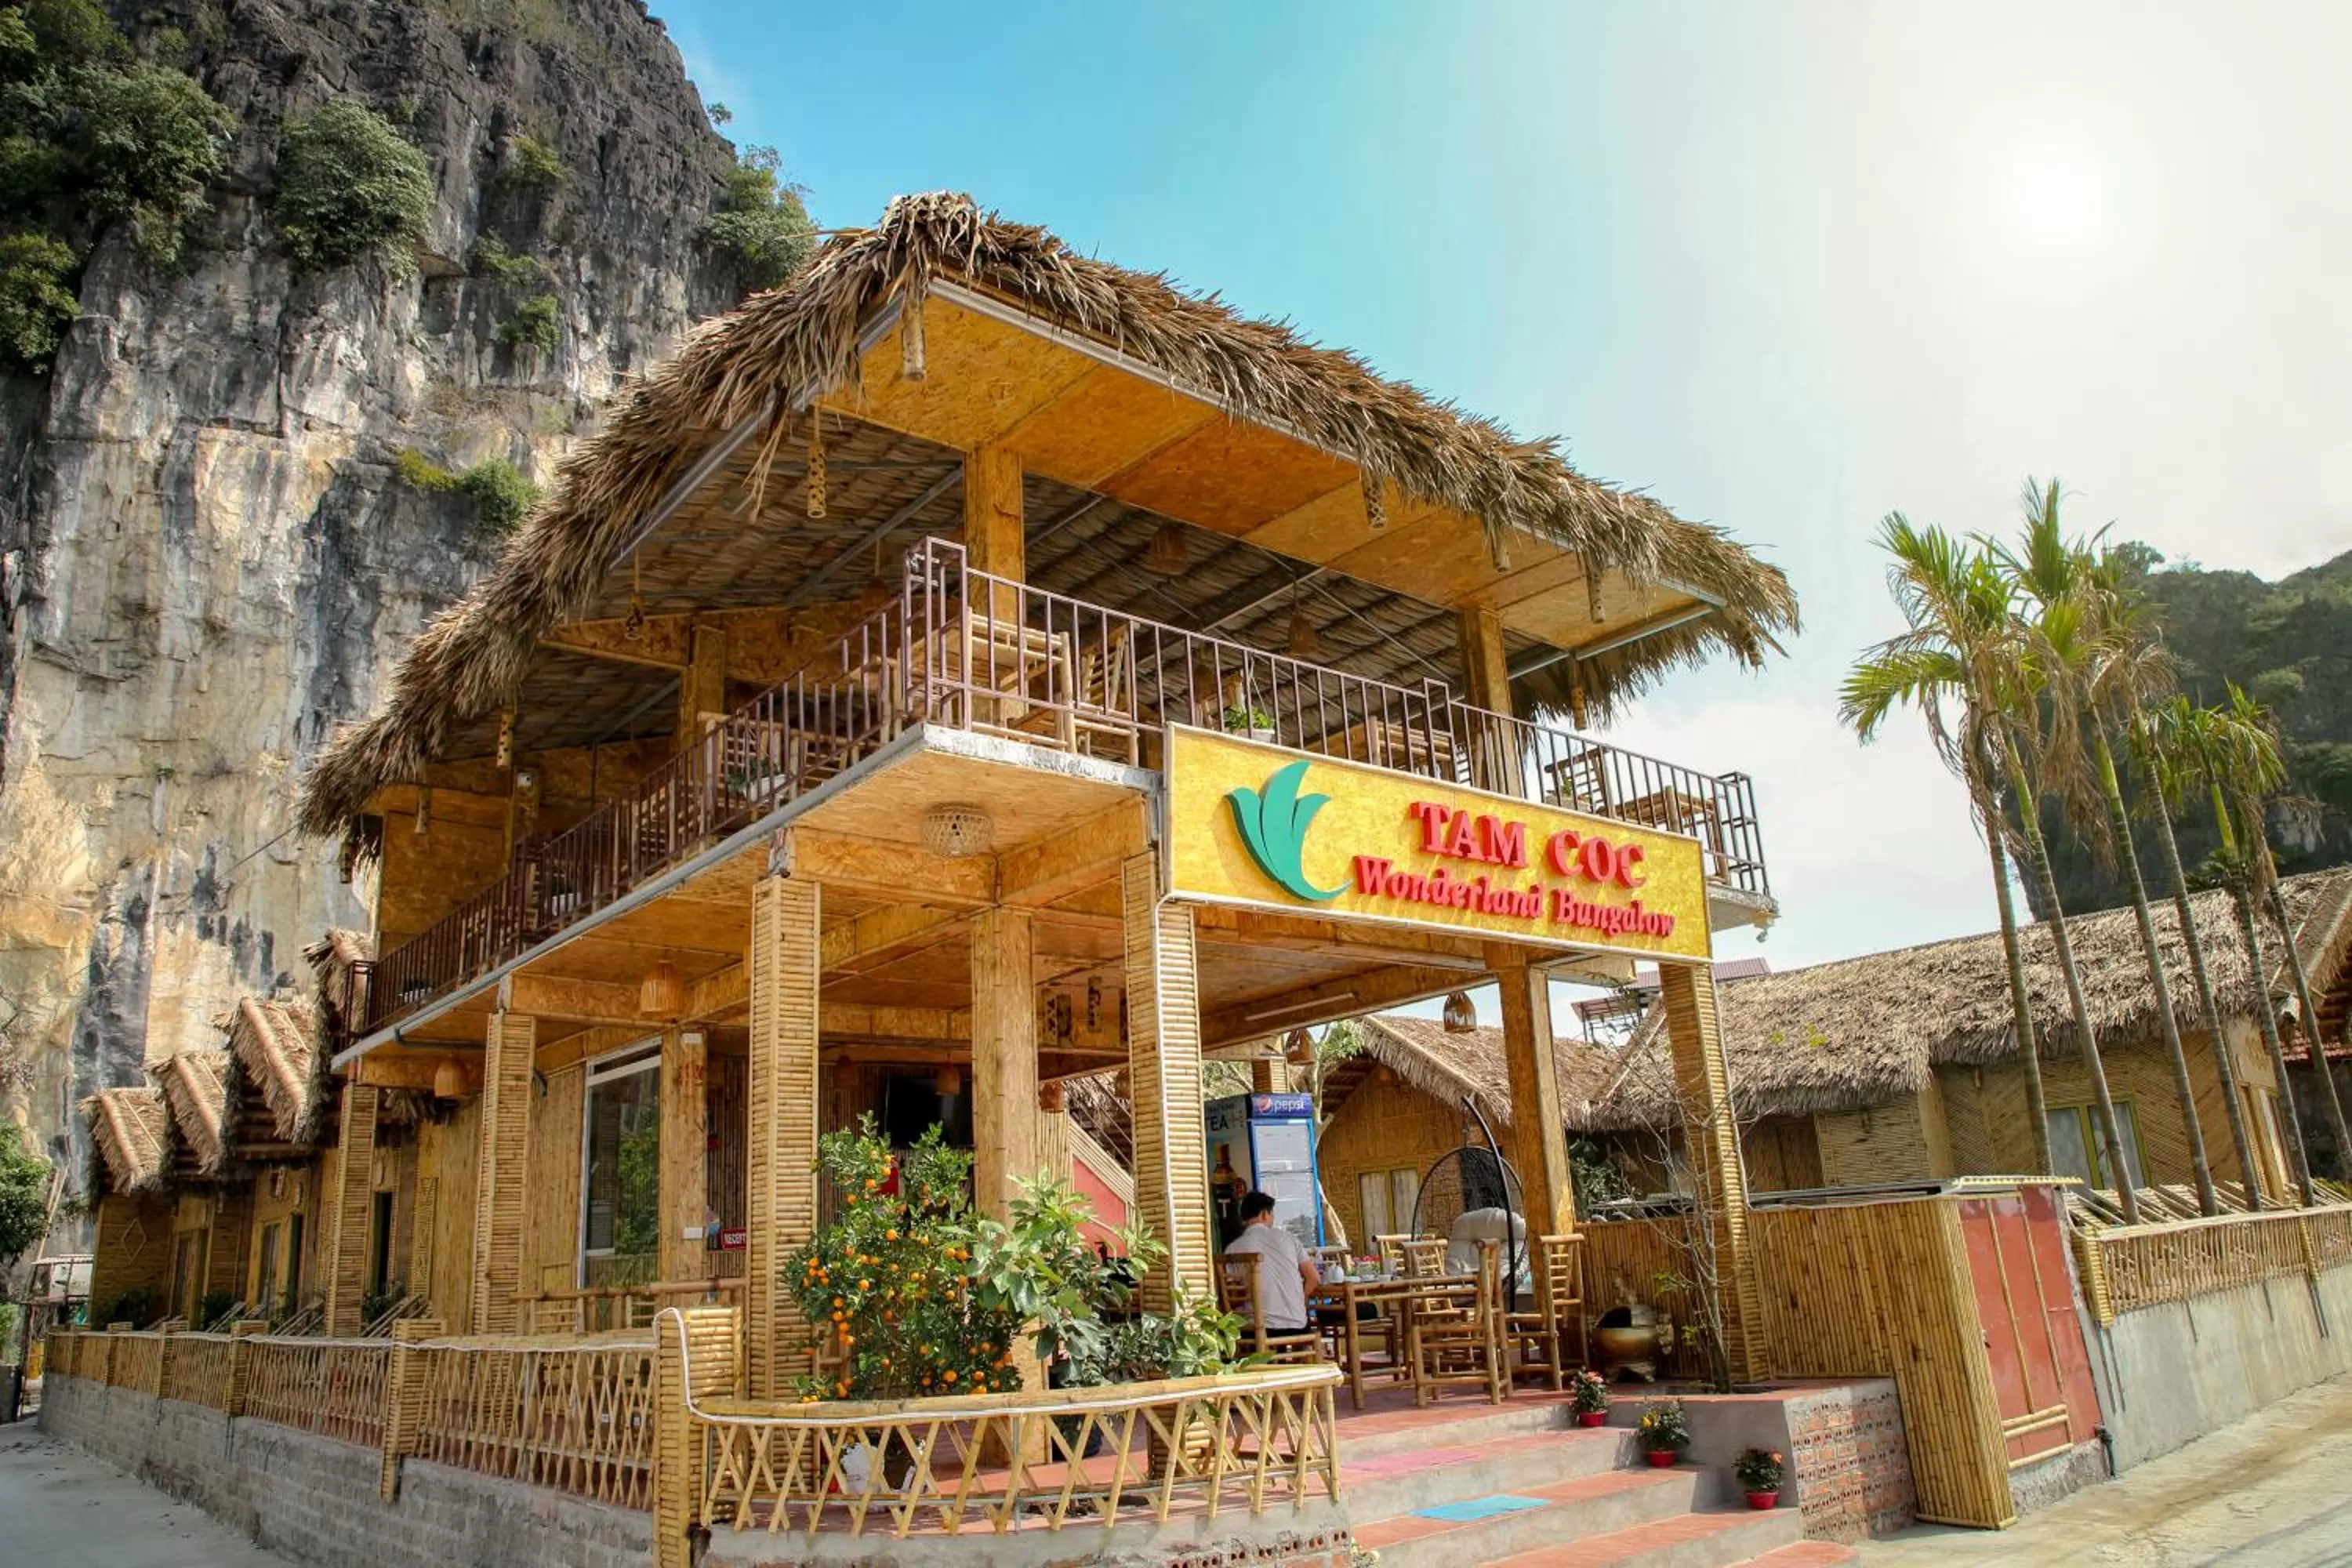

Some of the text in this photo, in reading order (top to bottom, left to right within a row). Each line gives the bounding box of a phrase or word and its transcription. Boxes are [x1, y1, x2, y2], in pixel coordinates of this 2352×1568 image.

[1411, 802, 1645, 887] TAM COC
[1355, 855, 1675, 936] Wonderland Bungalow
[1275, 1098, 1305, 1112] pepsi
